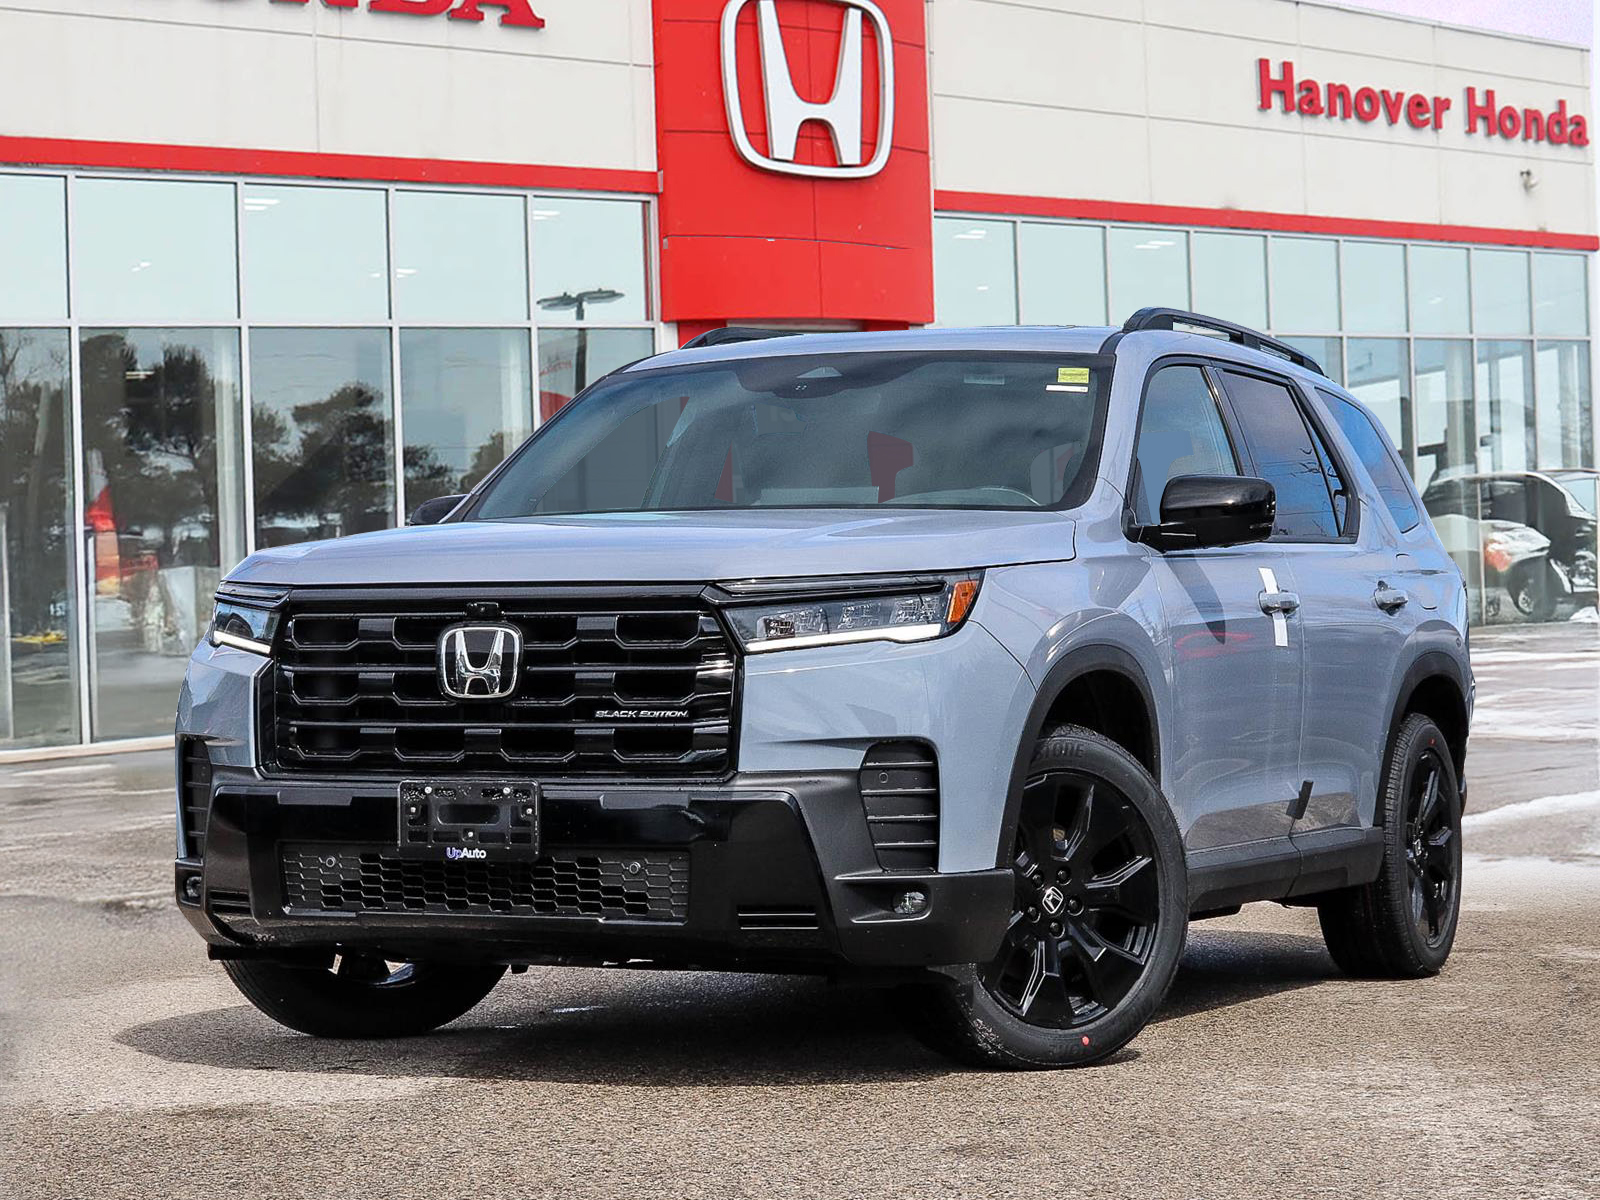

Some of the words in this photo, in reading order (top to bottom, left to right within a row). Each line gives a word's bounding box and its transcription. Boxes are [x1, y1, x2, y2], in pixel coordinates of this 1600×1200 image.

[1257, 58, 1452, 130] Hanover
[1465, 86, 1590, 147] Honda
[595, 710, 638, 718] BLACK
[639, 710, 689, 718] EDITION
[446, 847, 487, 860] UpAuto
